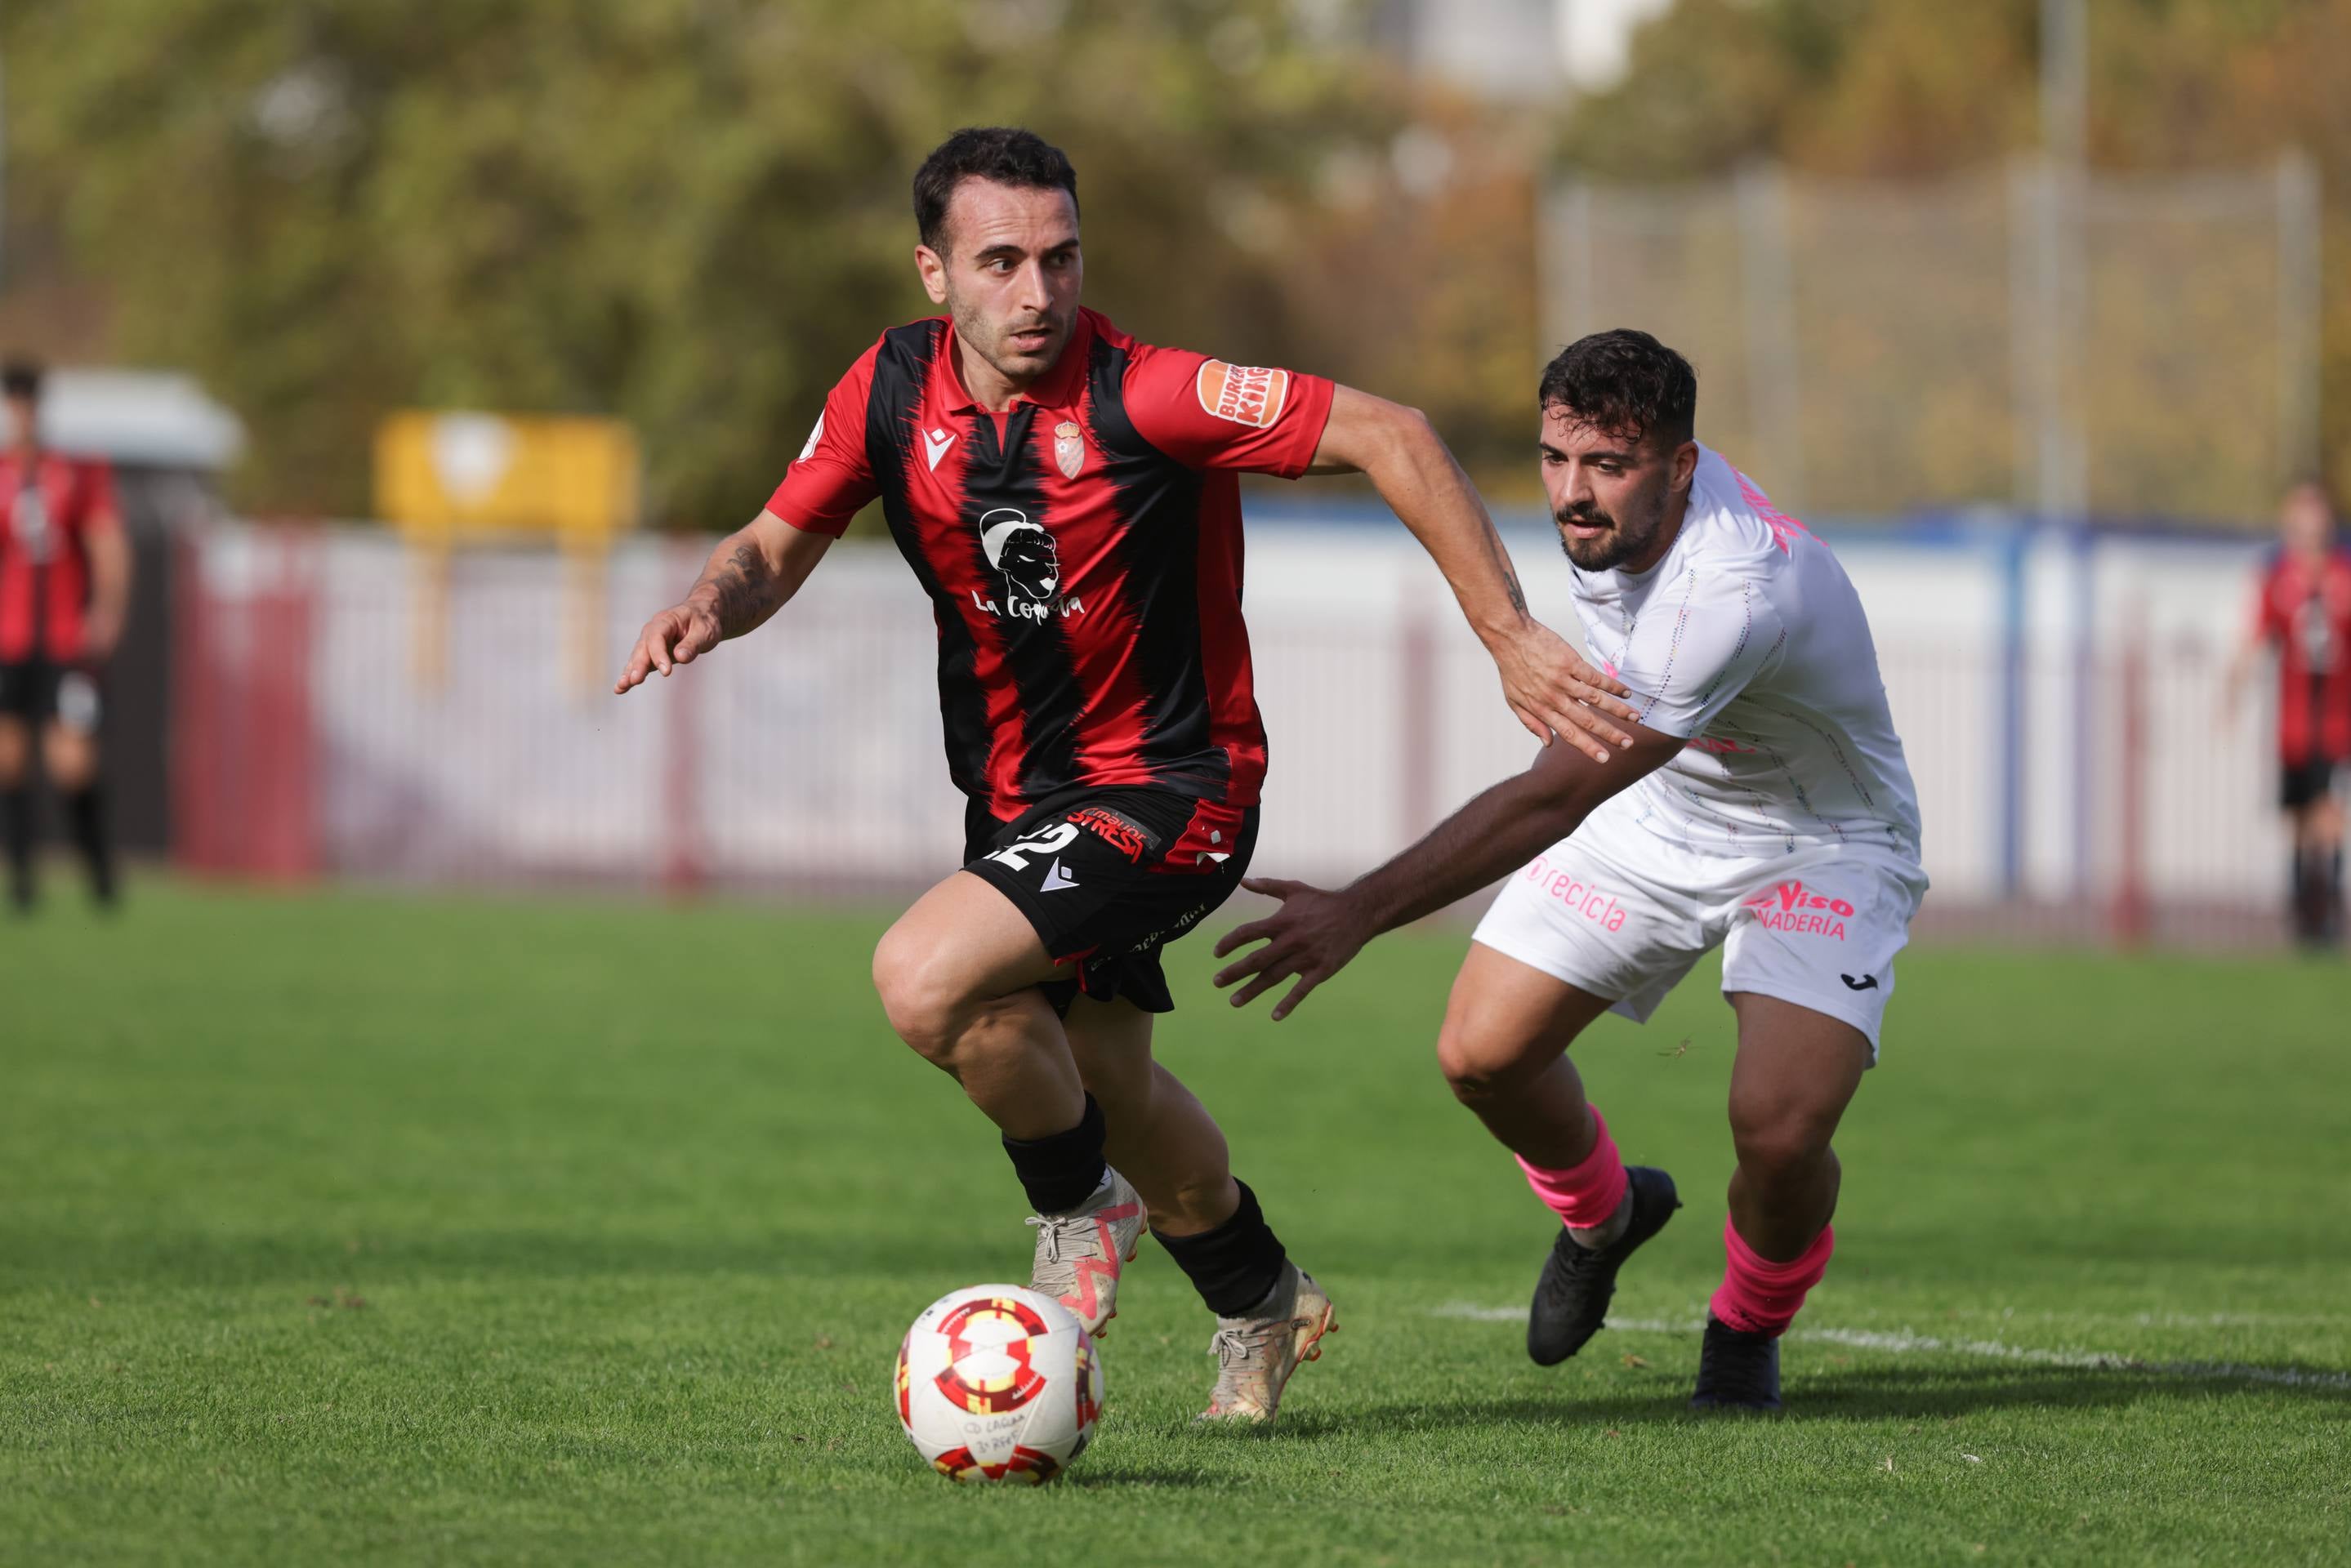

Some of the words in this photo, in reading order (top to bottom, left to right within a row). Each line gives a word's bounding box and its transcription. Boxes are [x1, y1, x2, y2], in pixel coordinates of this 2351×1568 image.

[1236, 367, 1271, 424] KING
[971, 590, 1002, 617] La
[1777, 880, 1855, 918] Viso
